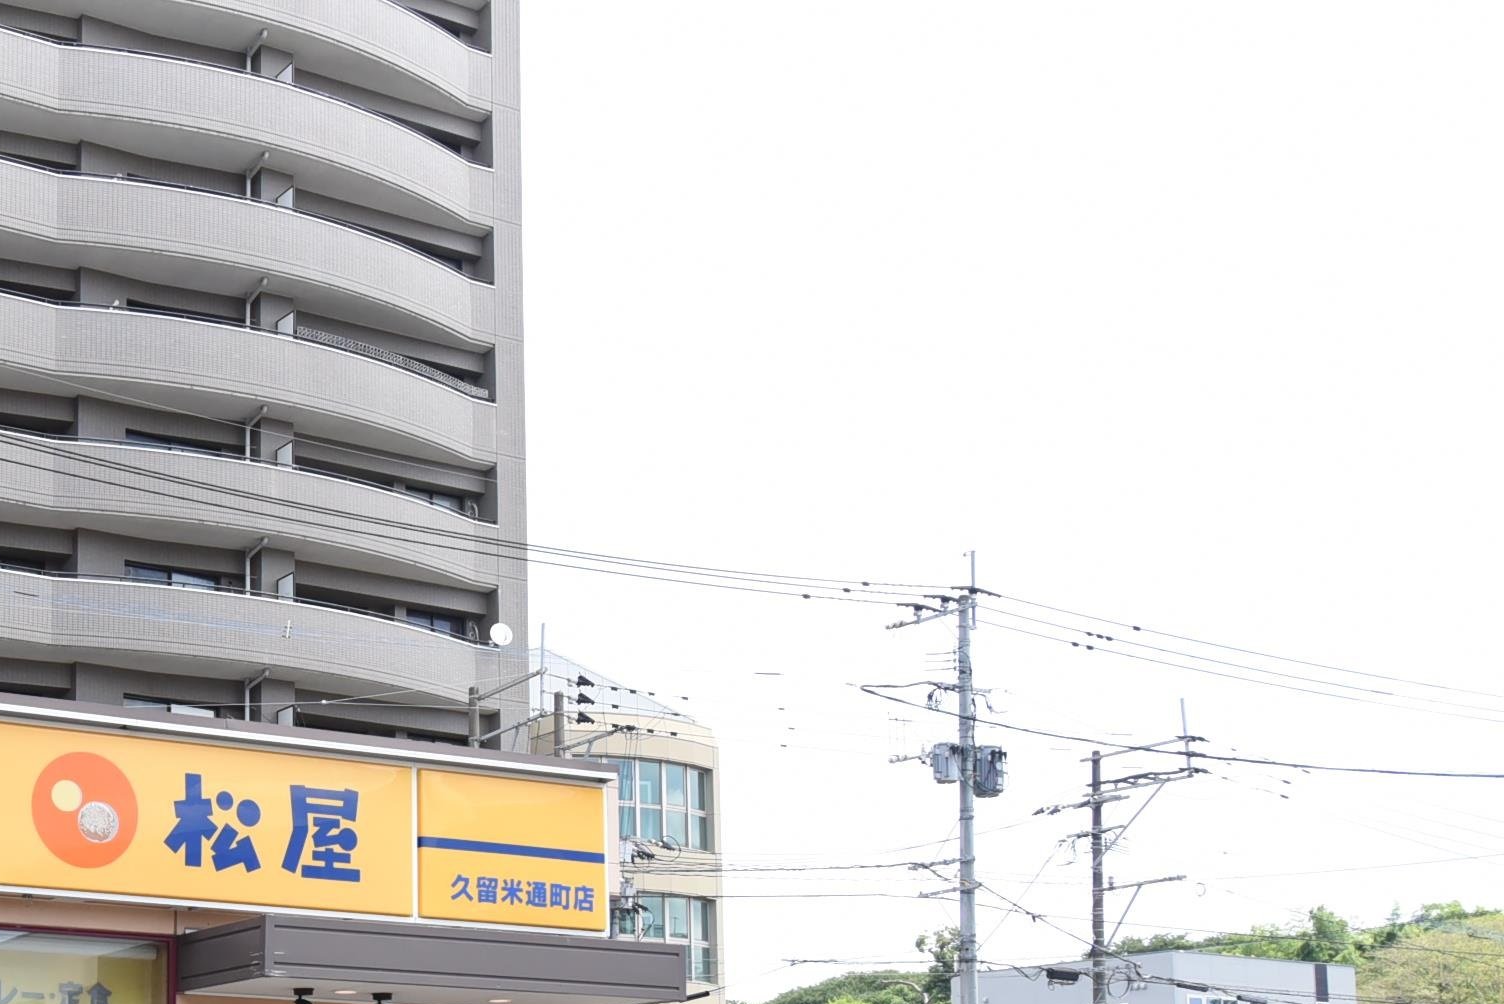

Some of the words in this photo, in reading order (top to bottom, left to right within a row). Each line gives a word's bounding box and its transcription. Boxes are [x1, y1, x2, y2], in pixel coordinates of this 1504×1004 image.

[164, 772, 361, 883] 松屋
[450, 873, 595, 913] 久留米通町店
